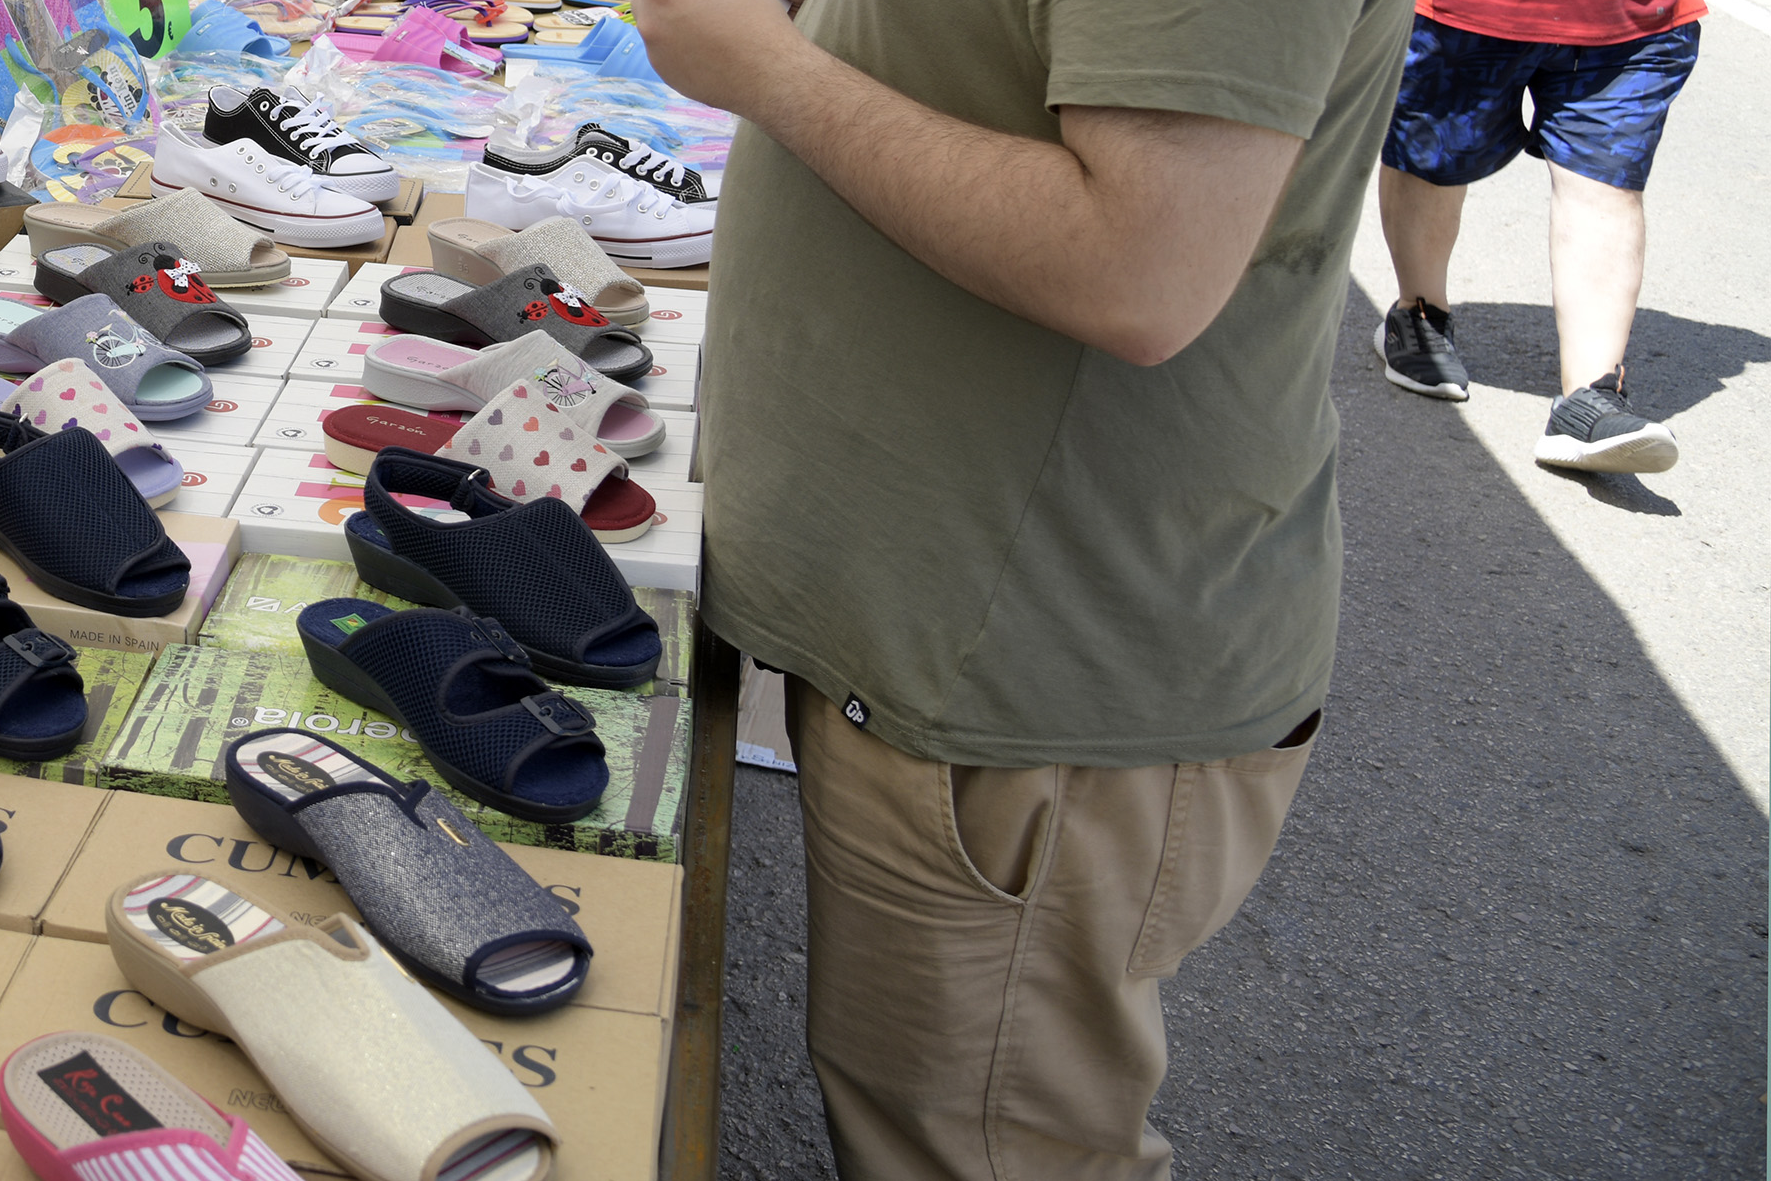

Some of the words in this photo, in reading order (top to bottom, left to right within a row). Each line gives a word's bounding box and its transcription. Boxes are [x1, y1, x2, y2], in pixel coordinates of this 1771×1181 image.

[366, 414, 427, 437] Garzón
[69, 628, 106, 644] MADE
[108, 633, 121, 646] IN
[123, 635, 160, 652] SPAIN
